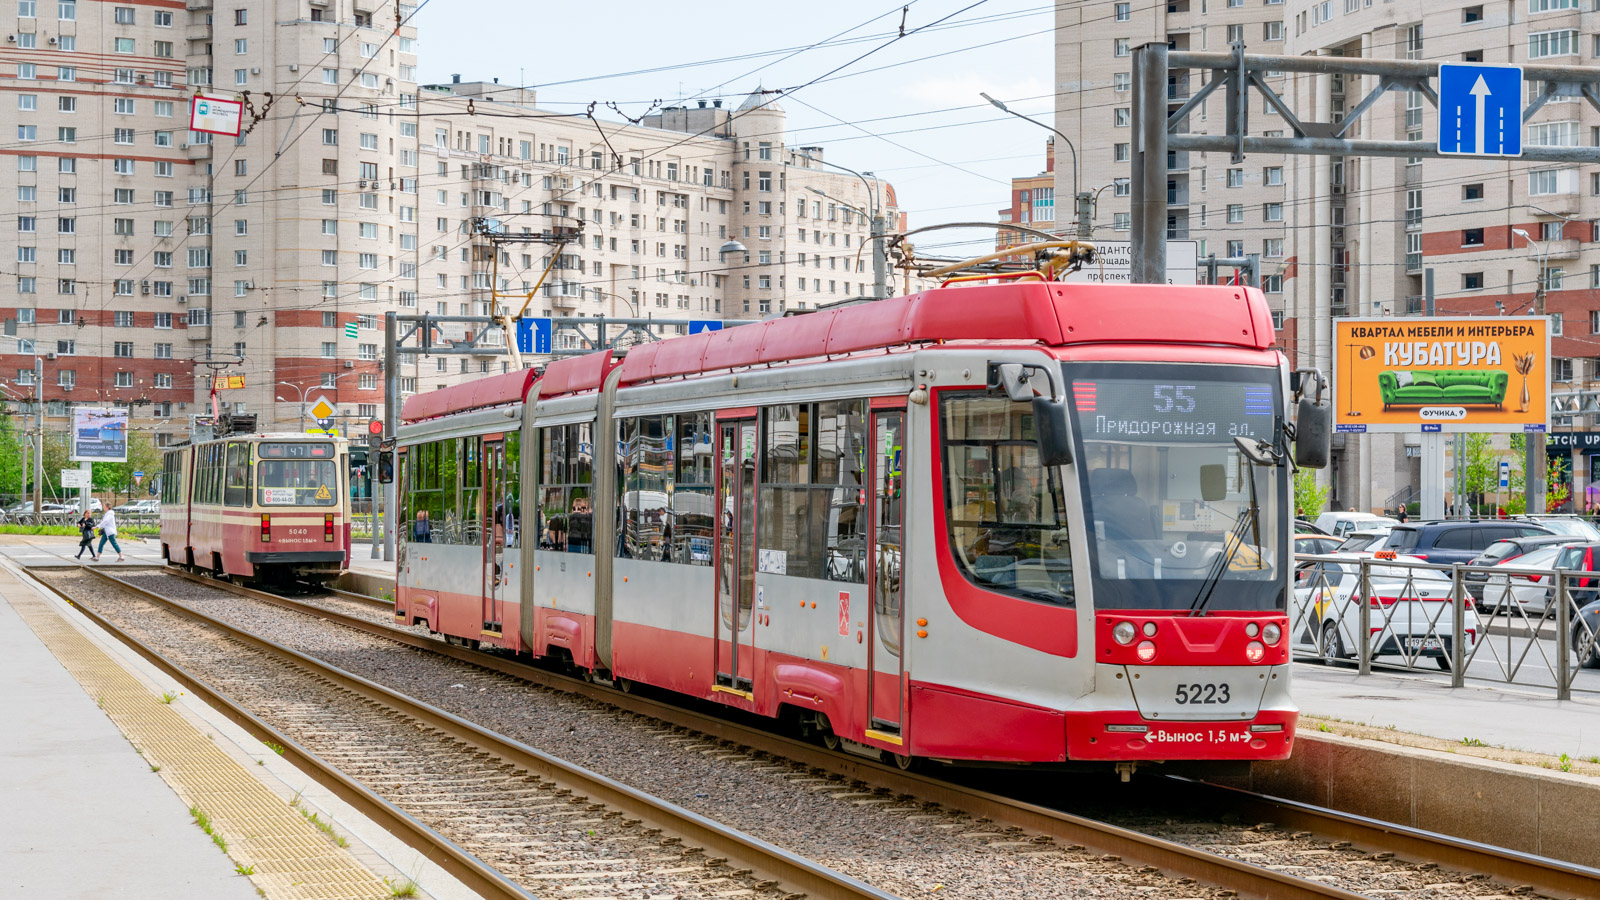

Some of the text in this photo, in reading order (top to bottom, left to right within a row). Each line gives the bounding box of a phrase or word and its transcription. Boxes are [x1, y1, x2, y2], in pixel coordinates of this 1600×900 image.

[1351, 325, 1535, 338] КВАРТАЛ МЕБЕЛИ И ИНТЕРЬЕРА
[1384, 341, 1502, 366] КУБАТУРА
[1153, 384, 1196, 413] 55
[1422, 409, 1458, 418] ФУЧИКА,
[1096, 415, 1255, 437] Придорожная ал.
[290, 446, 304, 456] 47
[1174, 683, 1231, 705] 5223
[1157, 730, 1240, 744] Вынос 1,5 м
